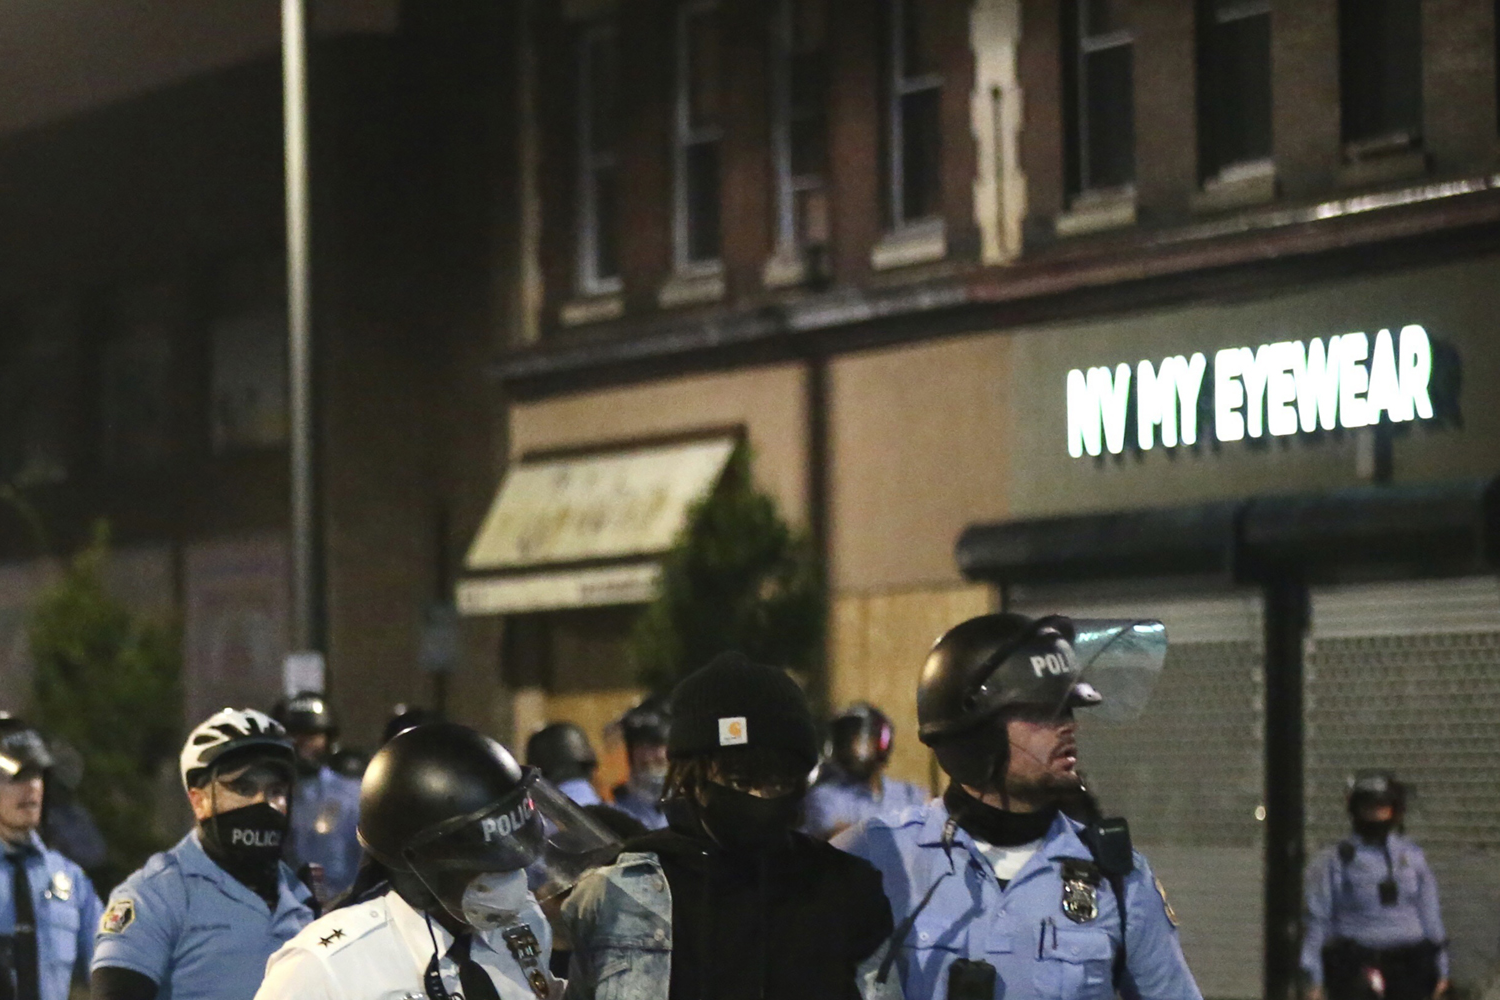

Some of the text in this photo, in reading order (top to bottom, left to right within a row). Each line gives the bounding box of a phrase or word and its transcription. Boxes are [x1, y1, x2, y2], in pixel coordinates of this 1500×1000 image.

[1066, 323, 1434, 458] NV MY EYEWEAR
[1029, 652, 1070, 678] POL
[481, 796, 534, 842] POLIC
[231, 827, 281, 848] POLIC
